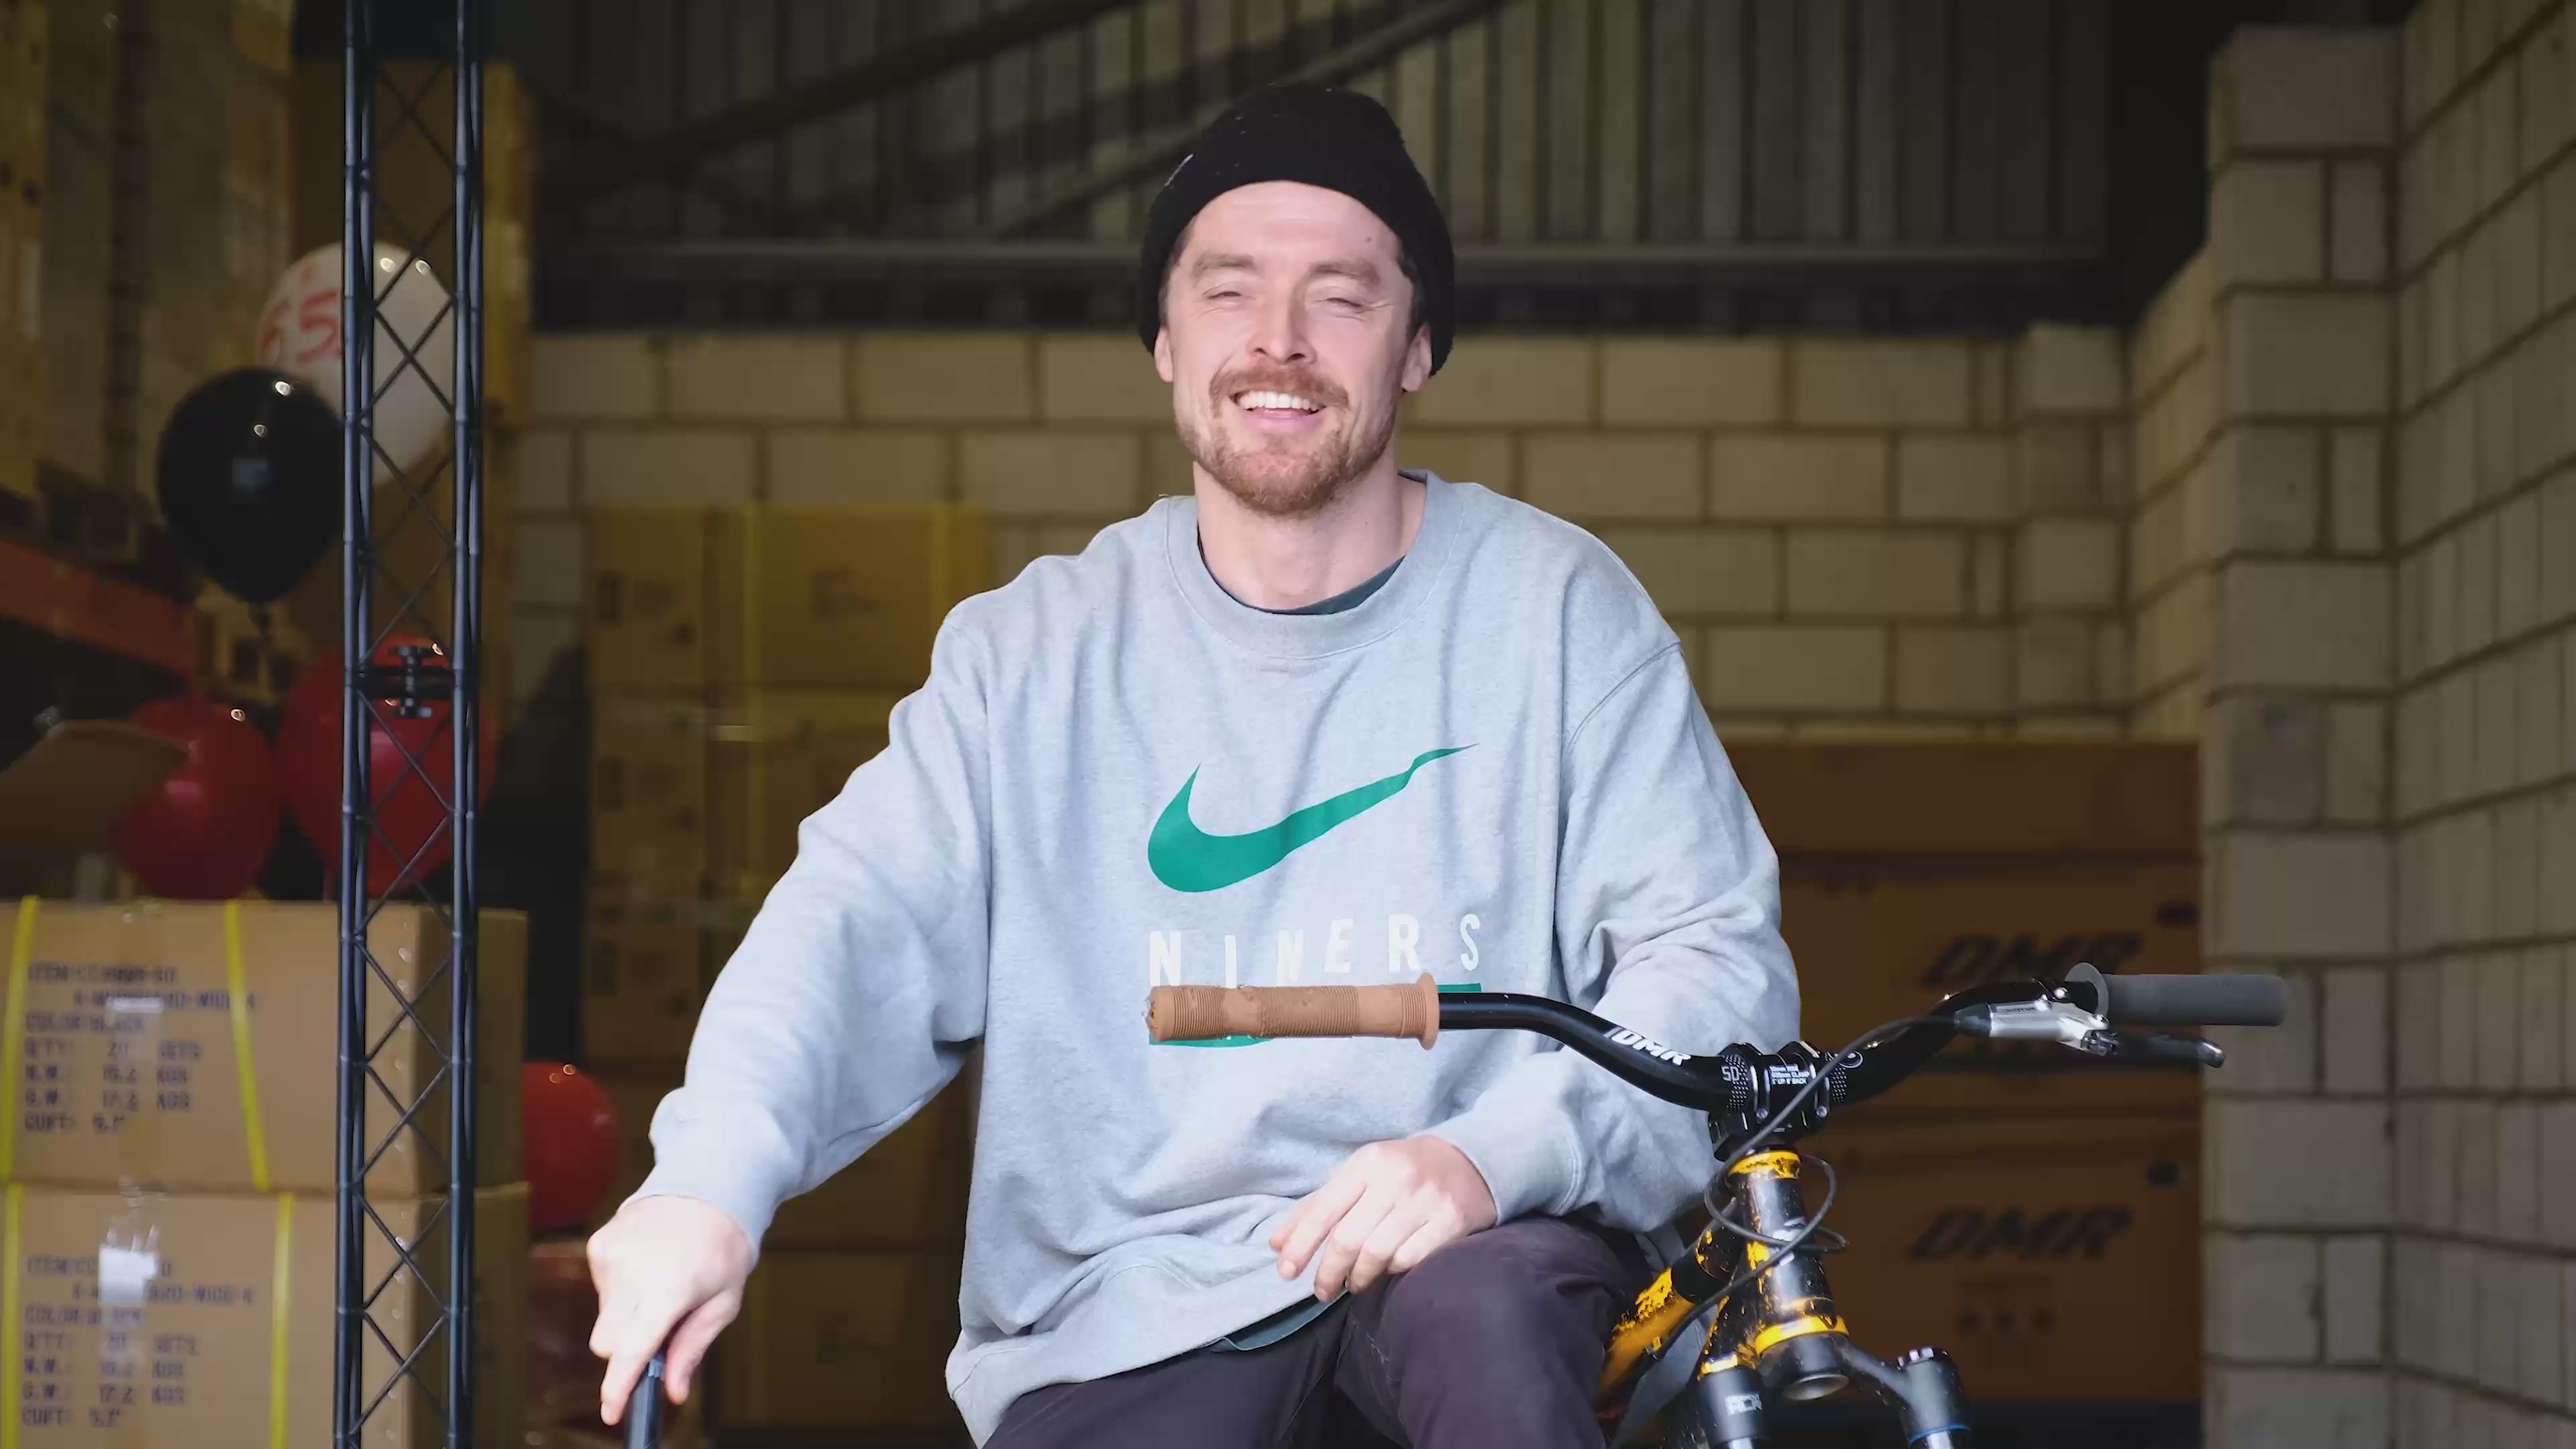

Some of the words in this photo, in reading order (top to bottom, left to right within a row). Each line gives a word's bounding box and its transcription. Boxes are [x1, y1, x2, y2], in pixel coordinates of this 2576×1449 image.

[1149, 913, 1481, 989] NINERS
[1611, 1029, 1692, 1067] DMR
[1909, 1207, 2135, 1262] DMR
